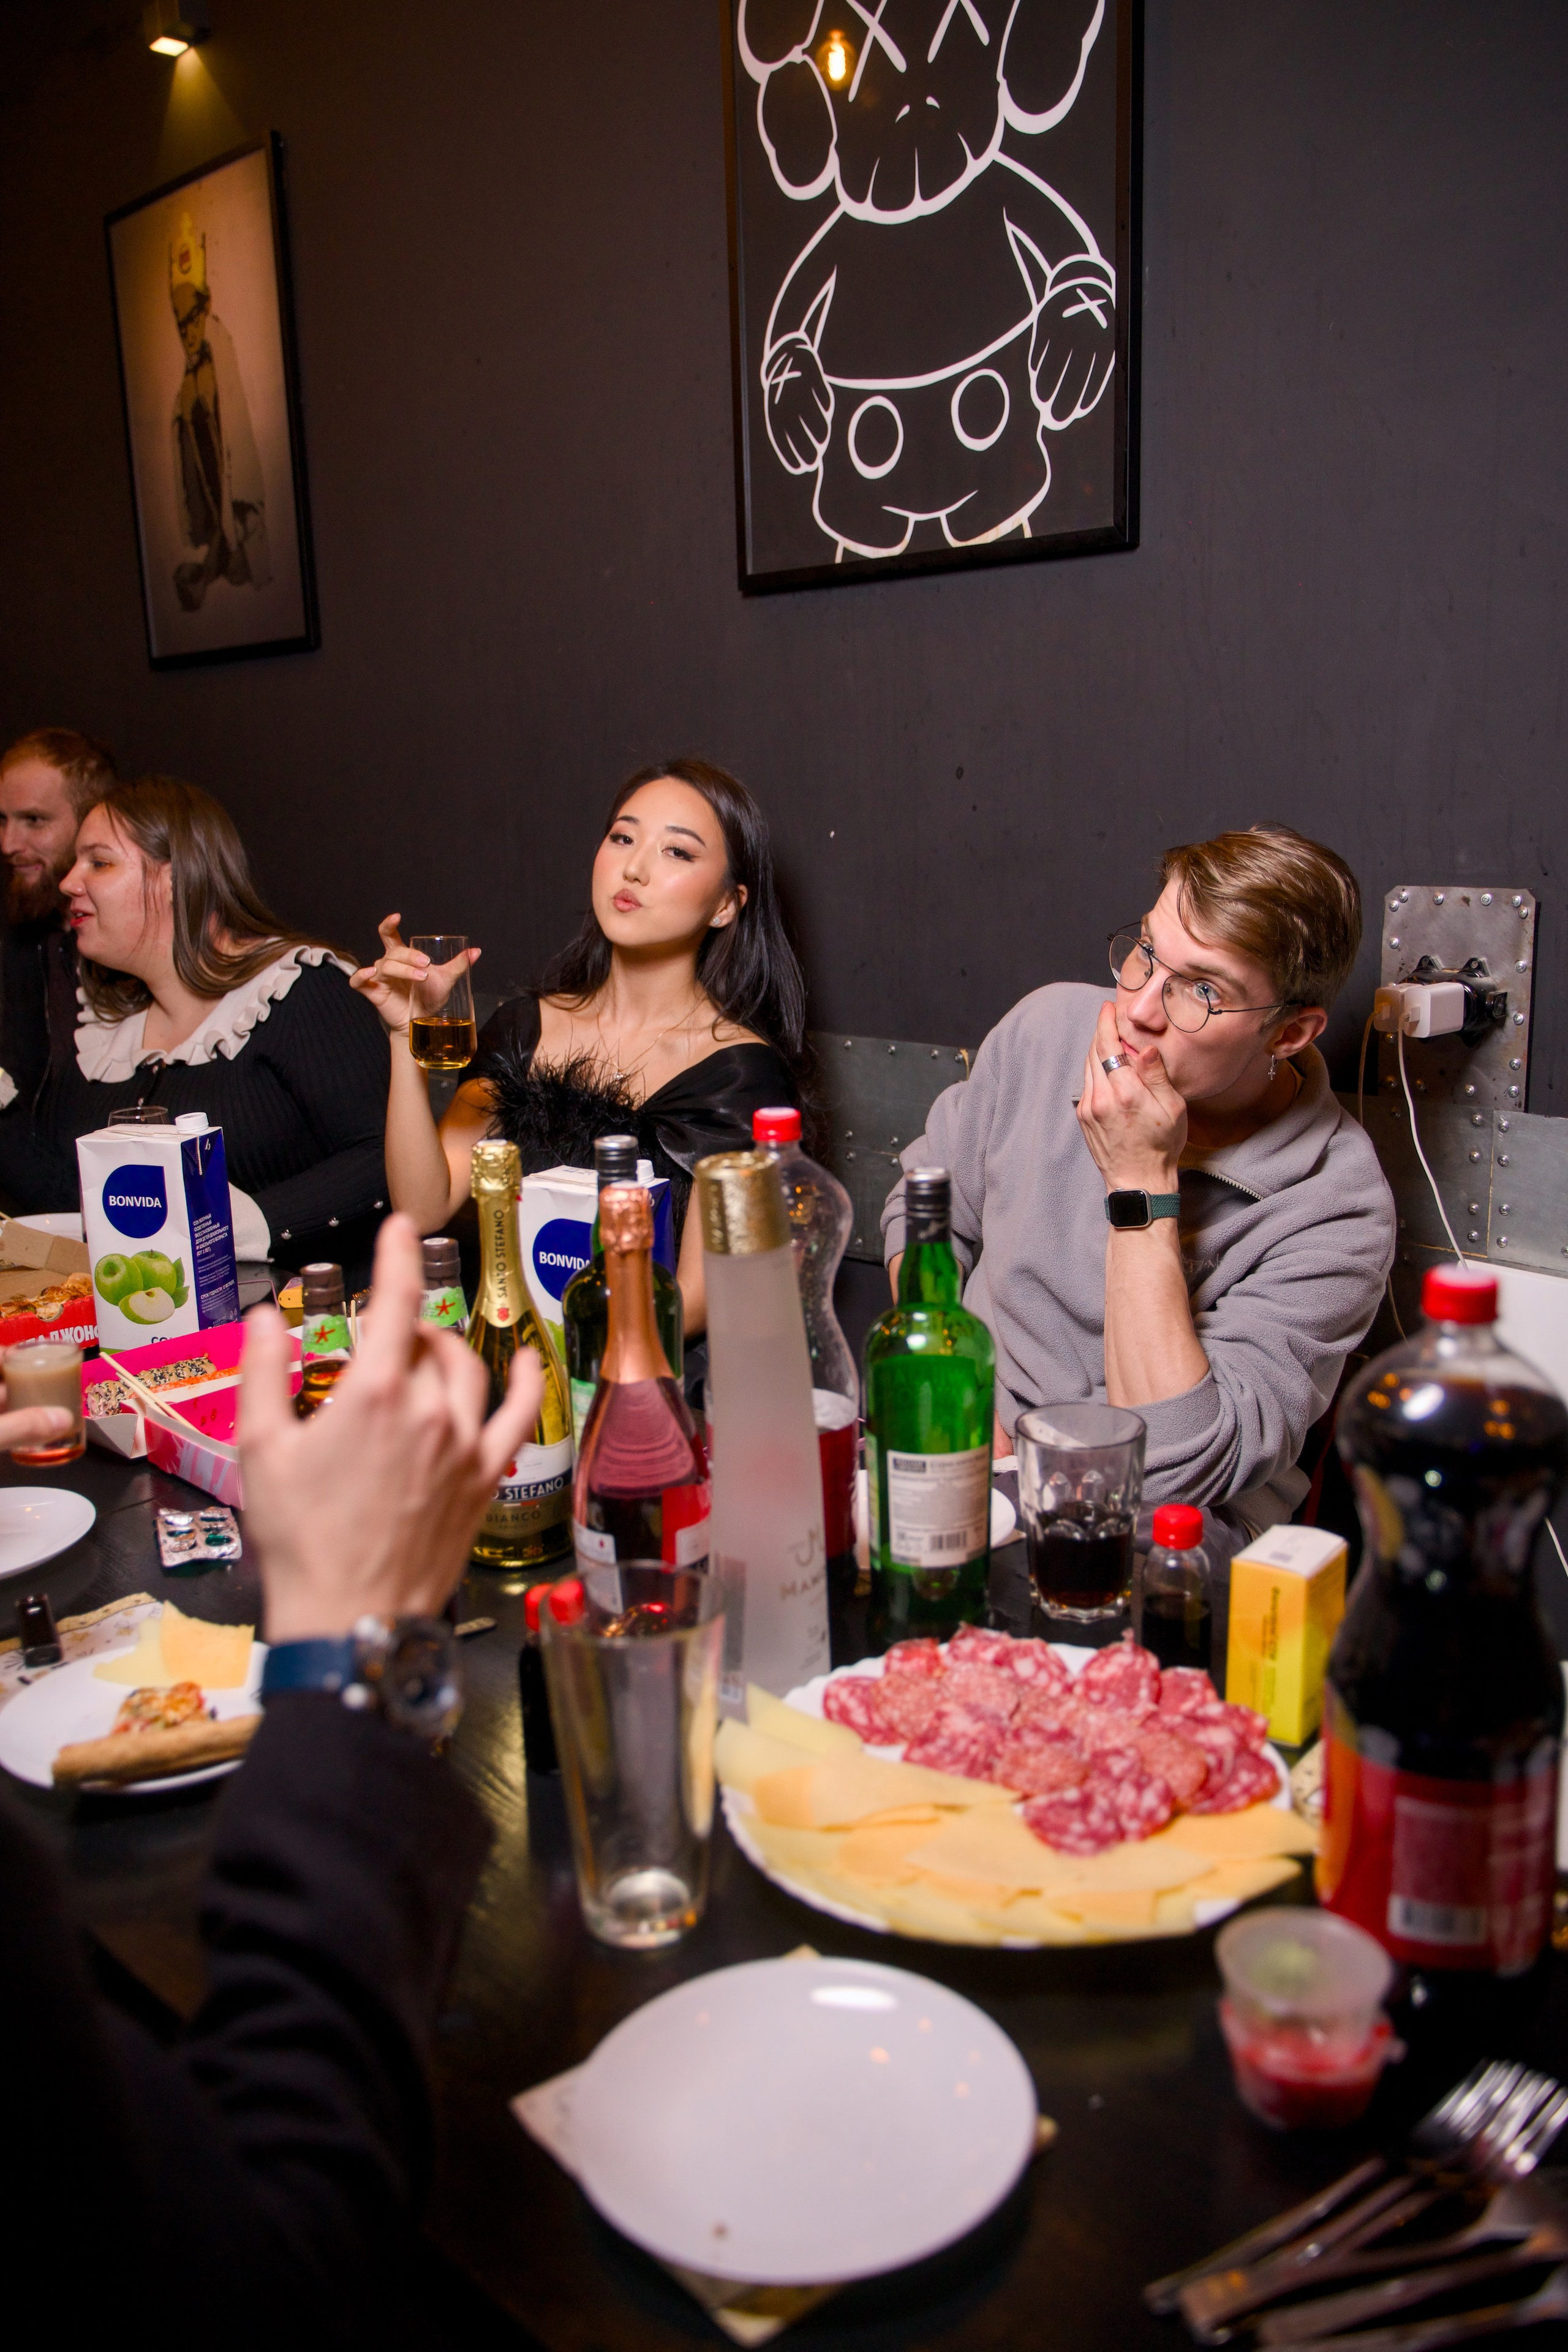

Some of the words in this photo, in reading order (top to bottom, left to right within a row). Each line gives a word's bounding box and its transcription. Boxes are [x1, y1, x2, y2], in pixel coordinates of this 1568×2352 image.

[109, 1196, 162, 1208] BONVIDA
[494, 1210, 505, 1258] STEFANO
[496, 1262, 507, 1298] SANTO
[505, 1477, 564, 1500] STEFANO
